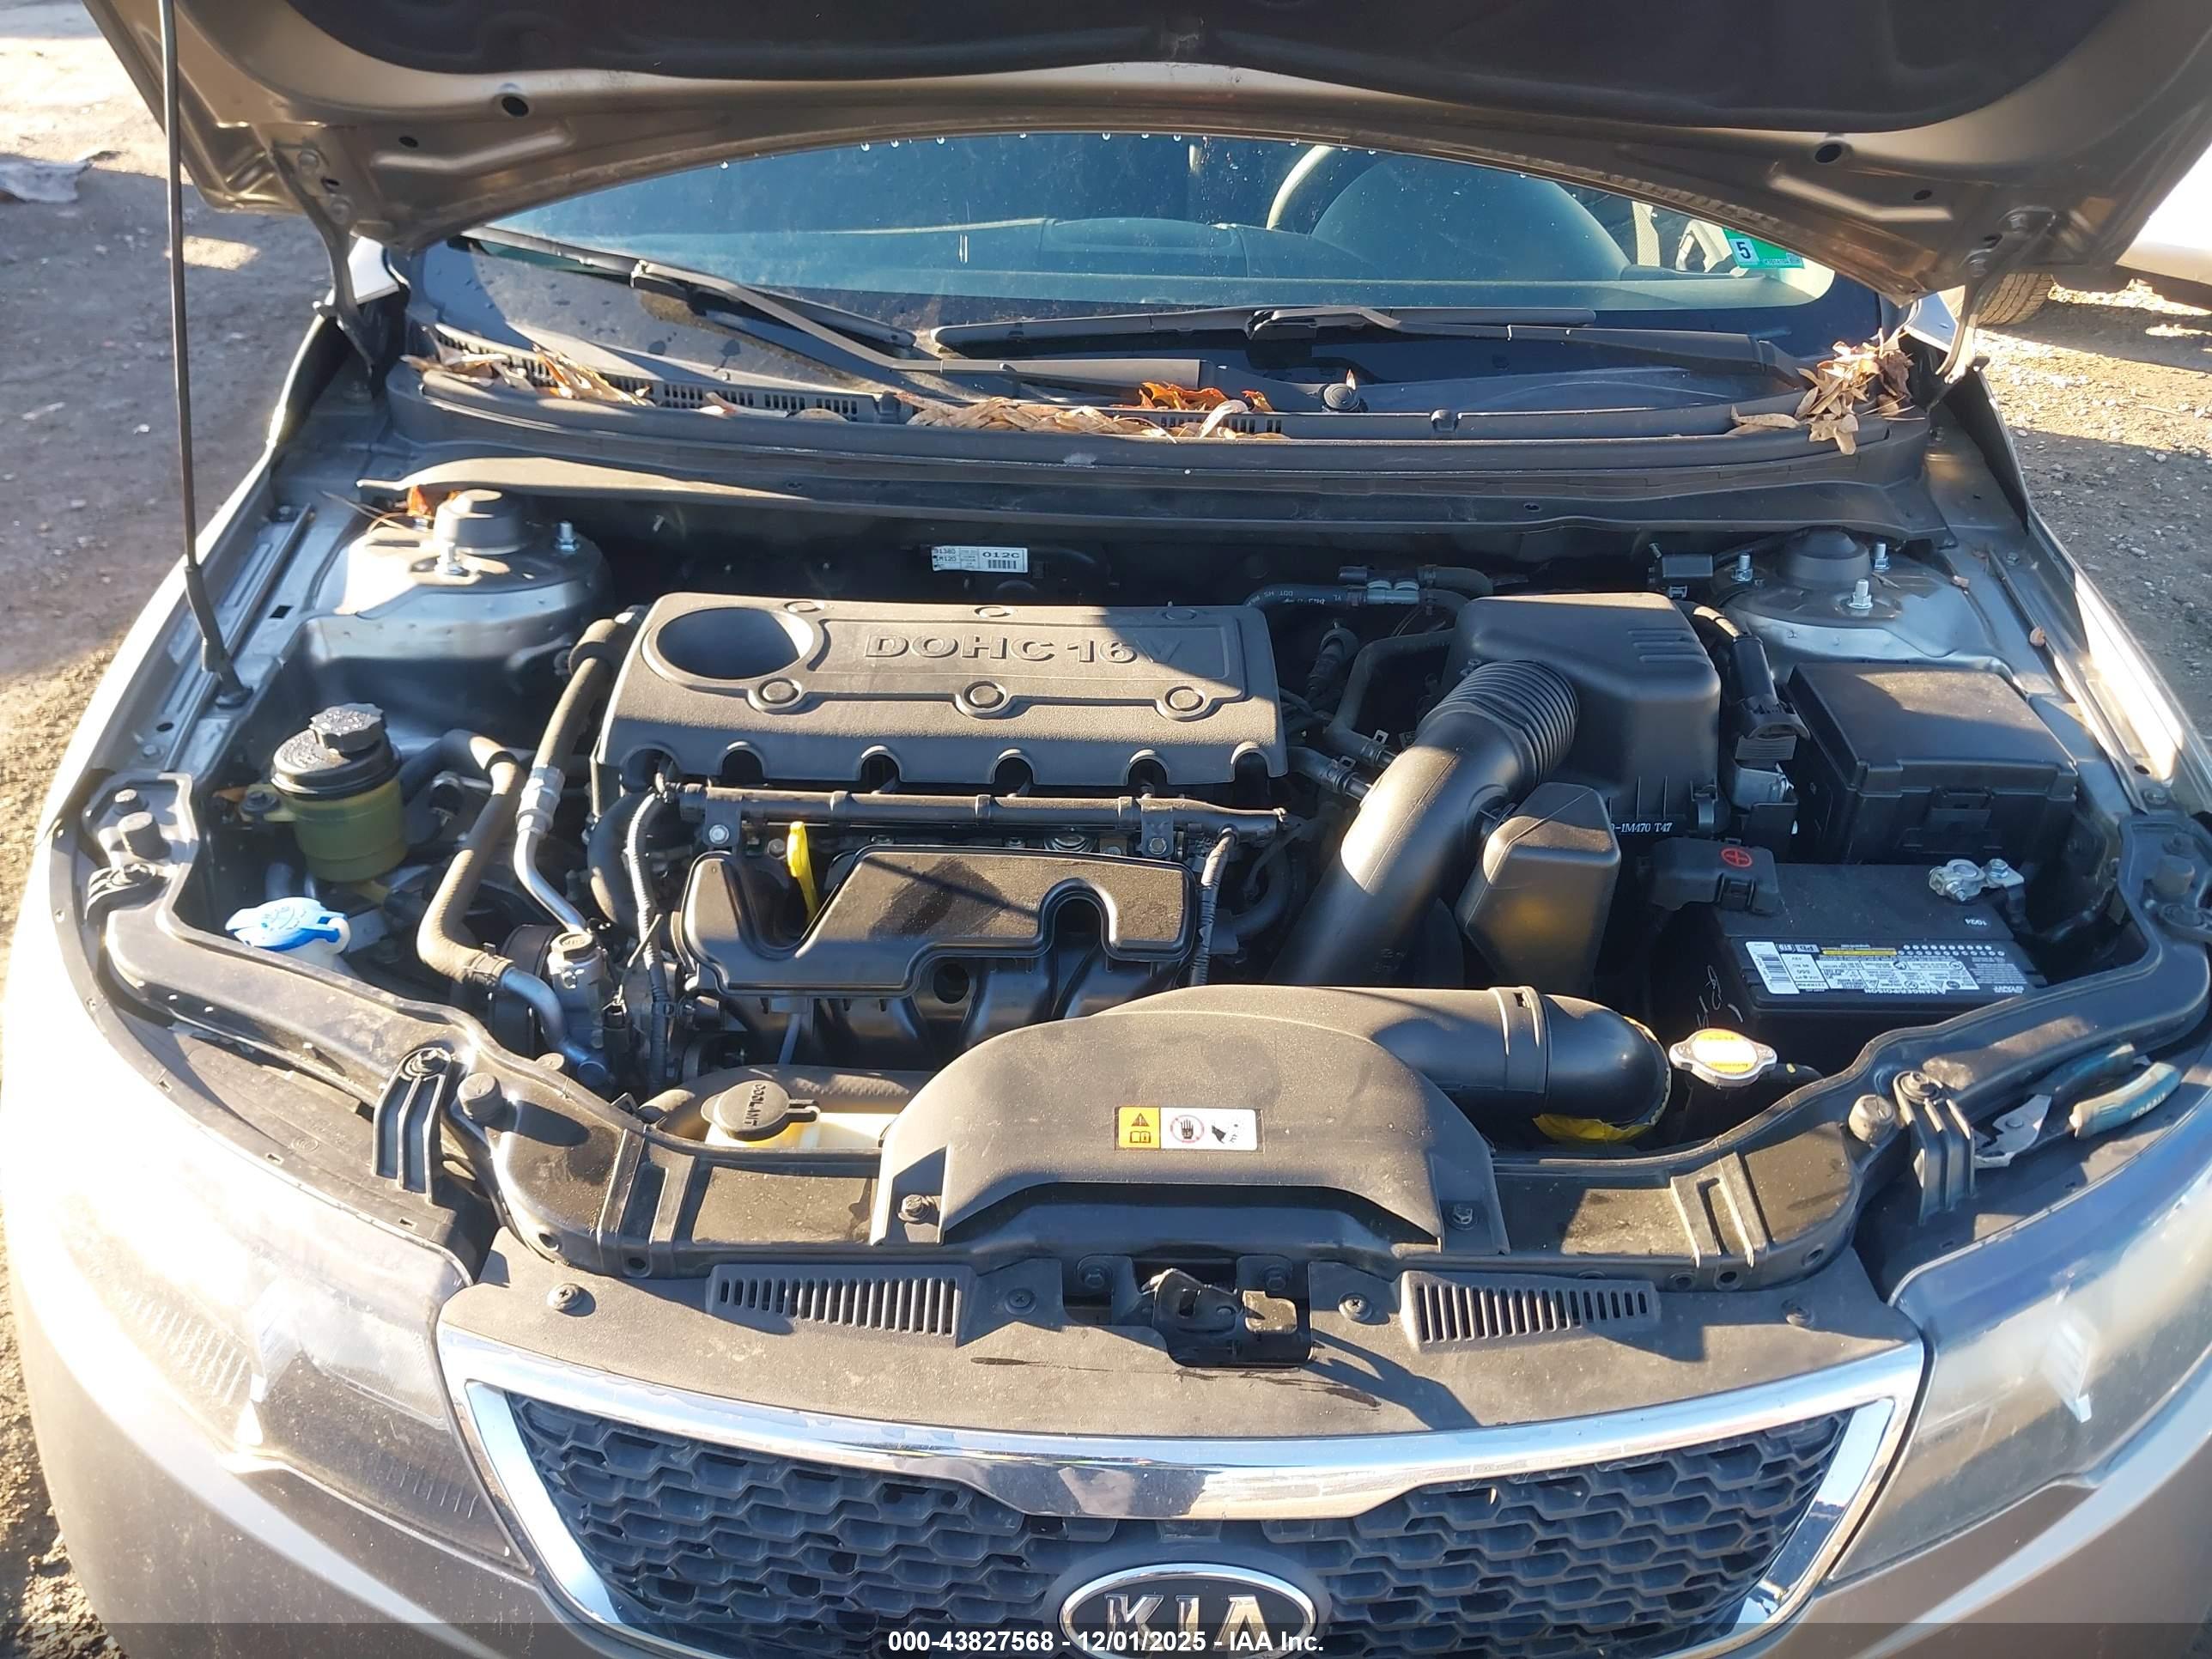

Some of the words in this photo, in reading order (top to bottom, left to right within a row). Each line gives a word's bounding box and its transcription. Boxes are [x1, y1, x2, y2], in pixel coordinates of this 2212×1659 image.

[1736, 241, 1751, 259] 5
[865, 634, 1055, 661] DOHC
[1066, 638, 1183, 665] 16V
[1654, 823, 1673, 833] T47
[744, 1084, 767, 1126] COOLANT
[1104, 1594, 1274, 1652] KIA
